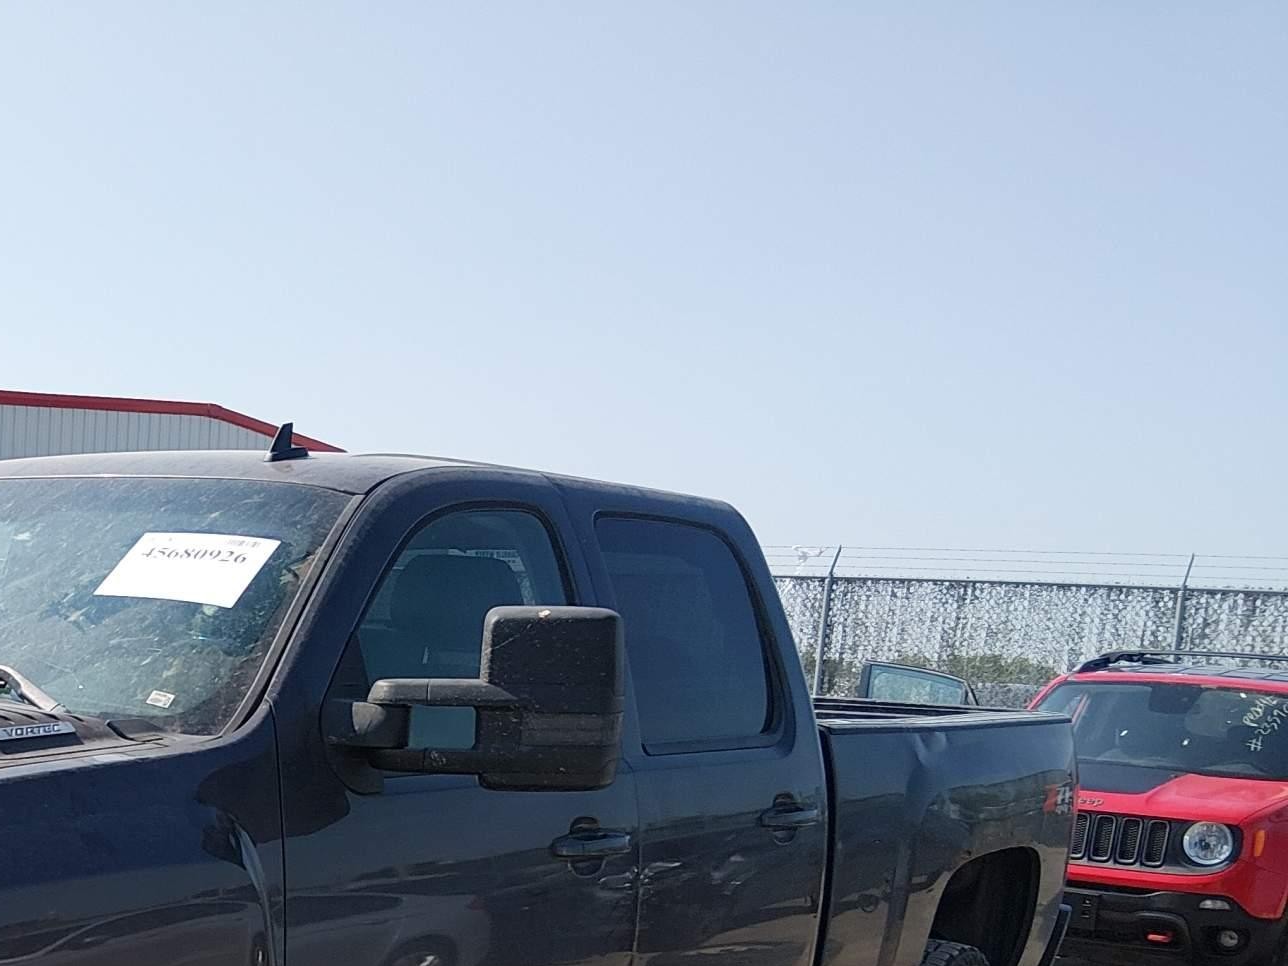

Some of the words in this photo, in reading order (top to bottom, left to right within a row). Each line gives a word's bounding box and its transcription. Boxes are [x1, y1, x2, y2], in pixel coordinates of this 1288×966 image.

[141, 546, 248, 565] 45680926
[3, 723, 62, 738] VORTEC
[1078, 797, 1104, 808] eep
